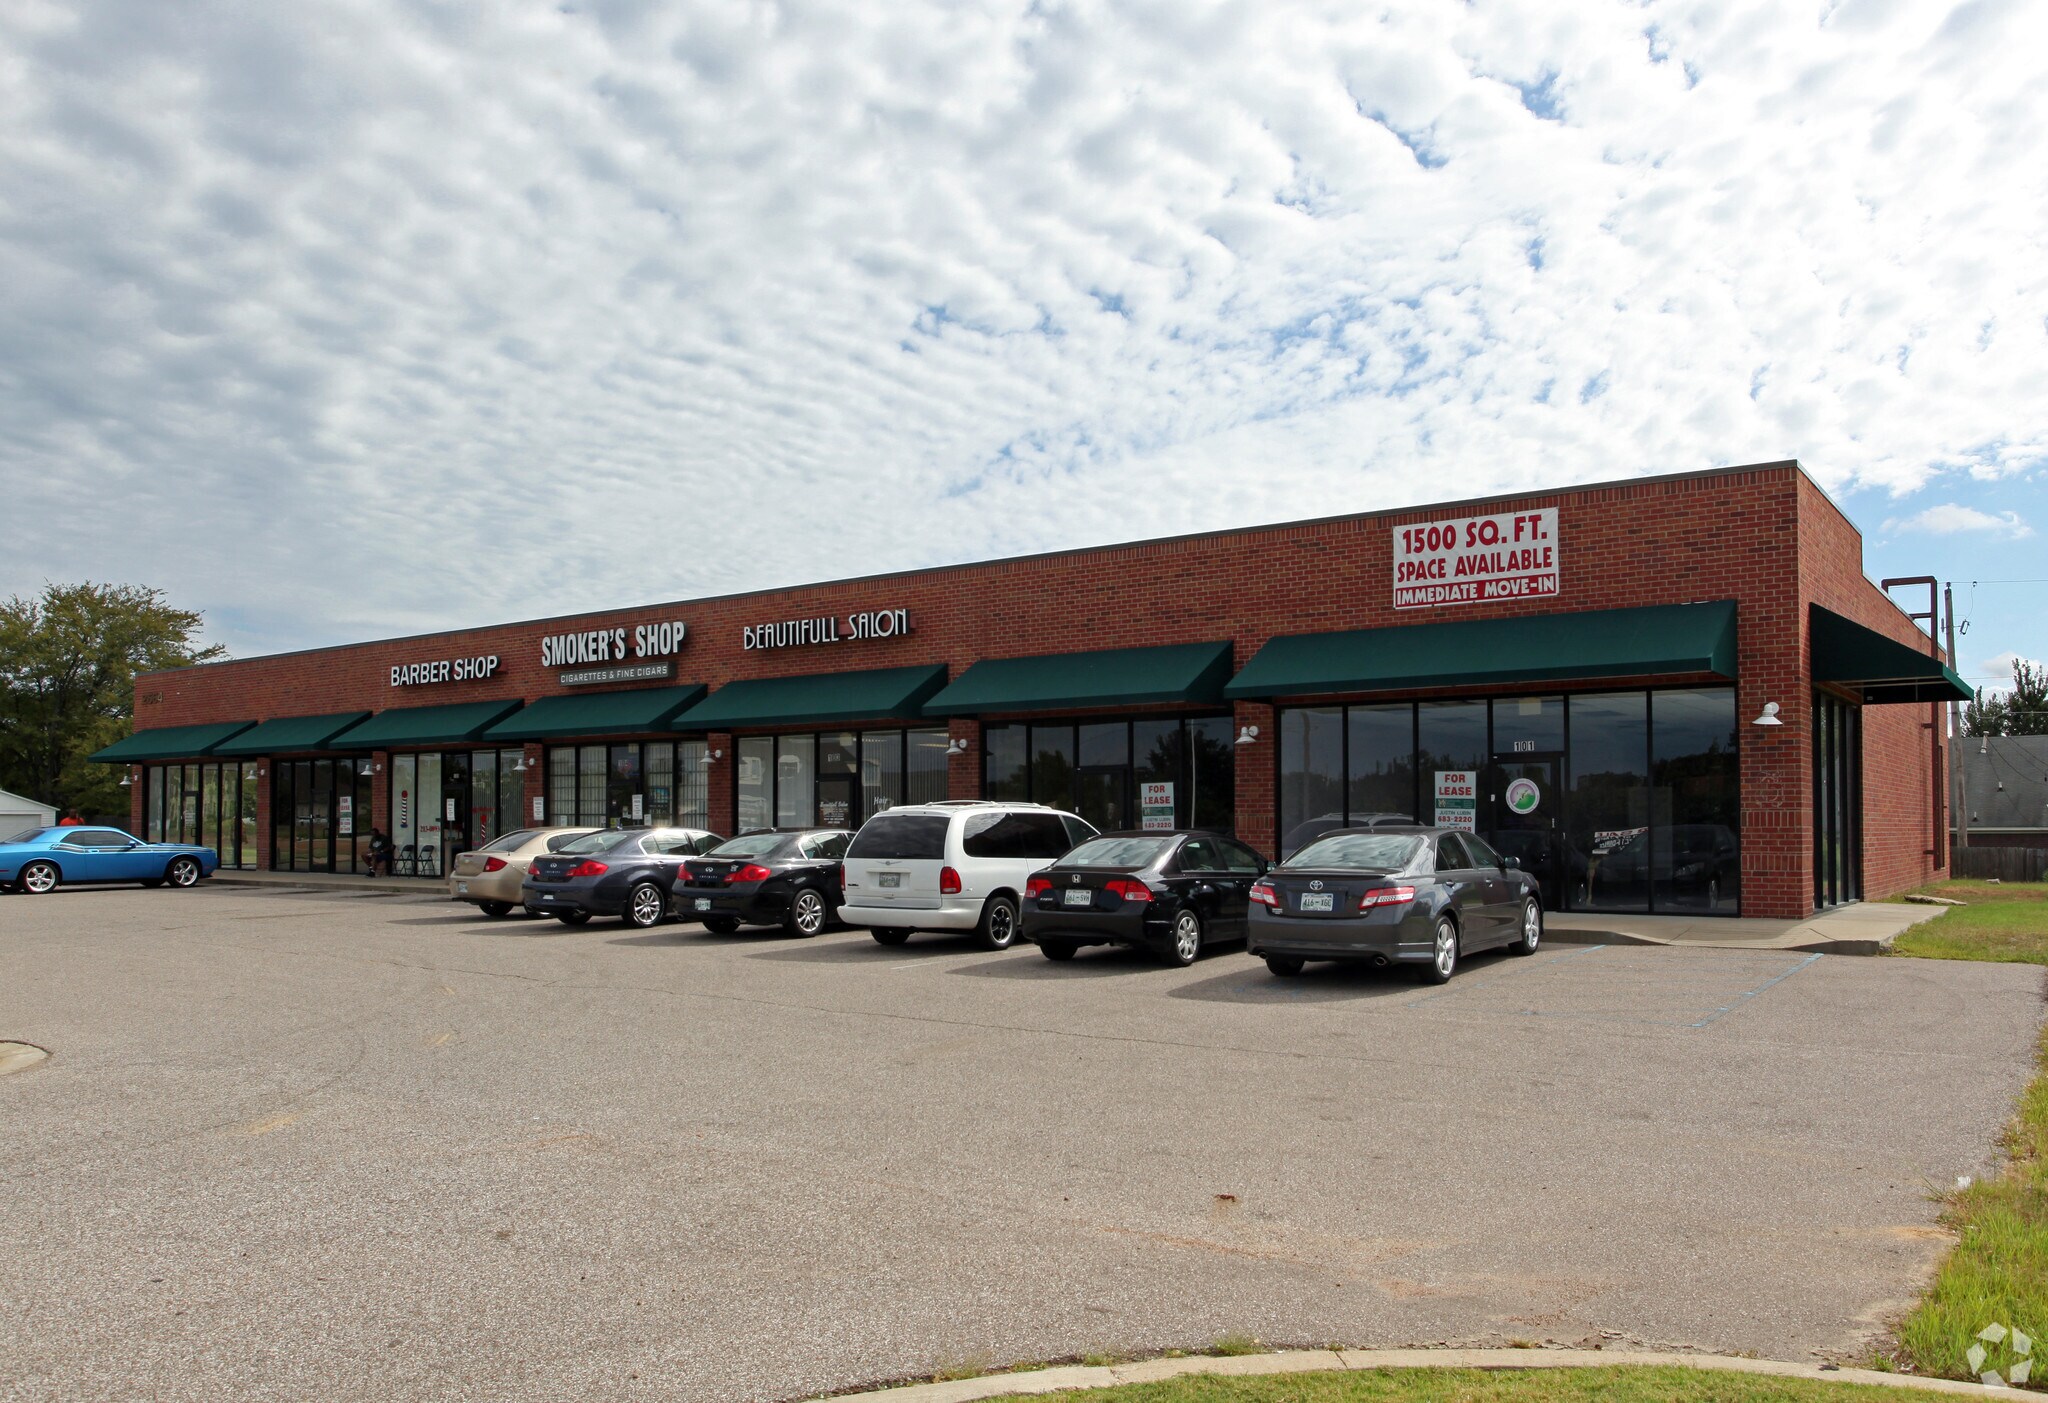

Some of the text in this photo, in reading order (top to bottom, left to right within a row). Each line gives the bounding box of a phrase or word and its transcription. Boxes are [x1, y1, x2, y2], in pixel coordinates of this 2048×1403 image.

[1402, 514, 1548, 554] 1500 SQ. FT.
[1397, 546, 1552, 583] SPACE AVAILABLE
[1396, 575, 1555, 605] IMMEDIATE MOVE-IN
[743, 608, 907, 650] BEAUTIFULL SALON
[541, 621, 685, 667] SMOKER'S SHOP
[391, 655, 498, 687] BARBER SHOP
[560, 665, 668, 683] CIGARETTES & FINE CIGARS
[1513, 740, 1535, 752] 101
[1148, 785, 1165, 793] FOR
[1444, 774, 1466, 783] FOR
[1144, 796, 1171, 805] LEASE
[1438, 786, 1472, 796] LEASE
